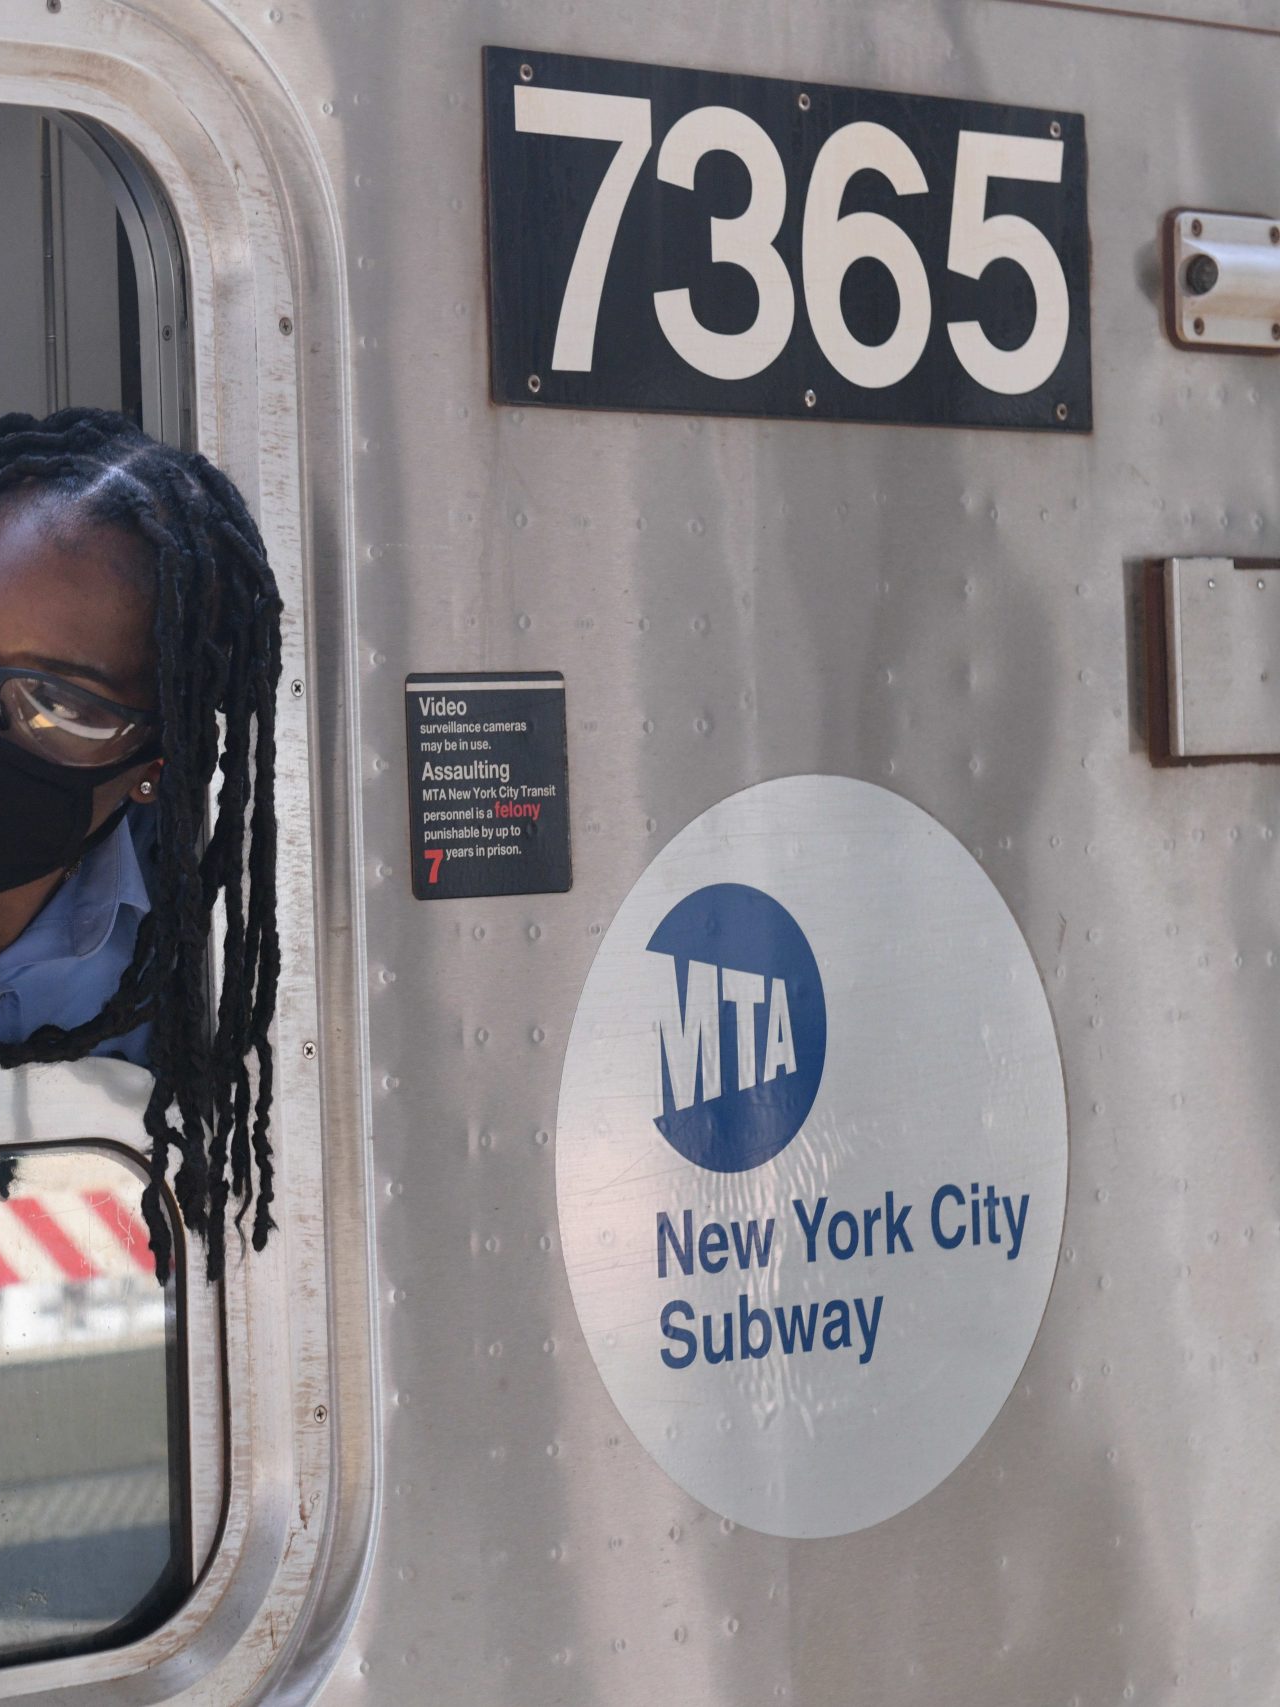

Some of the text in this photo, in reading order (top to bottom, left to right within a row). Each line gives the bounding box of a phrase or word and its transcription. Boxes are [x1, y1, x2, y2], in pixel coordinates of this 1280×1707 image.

[514, 85, 1070, 396] 7365
[419, 696, 468, 717] Video
[420, 720, 527, 734] surveillance cameras
[420, 739, 492, 753] may be in use.
[422, 760, 510, 782] Assaulting
[422, 784, 557, 801] MTA New York City Transit
[423, 800, 541, 824] personnel is a felony
[424, 824, 521, 843] punishable by up to
[423, 844, 522, 884] 7 years in prison.
[652, 953, 798, 1117] MTA
[656, 1182, 1030, 1279] New York City
[660, 1293, 884, 1370] Subway
